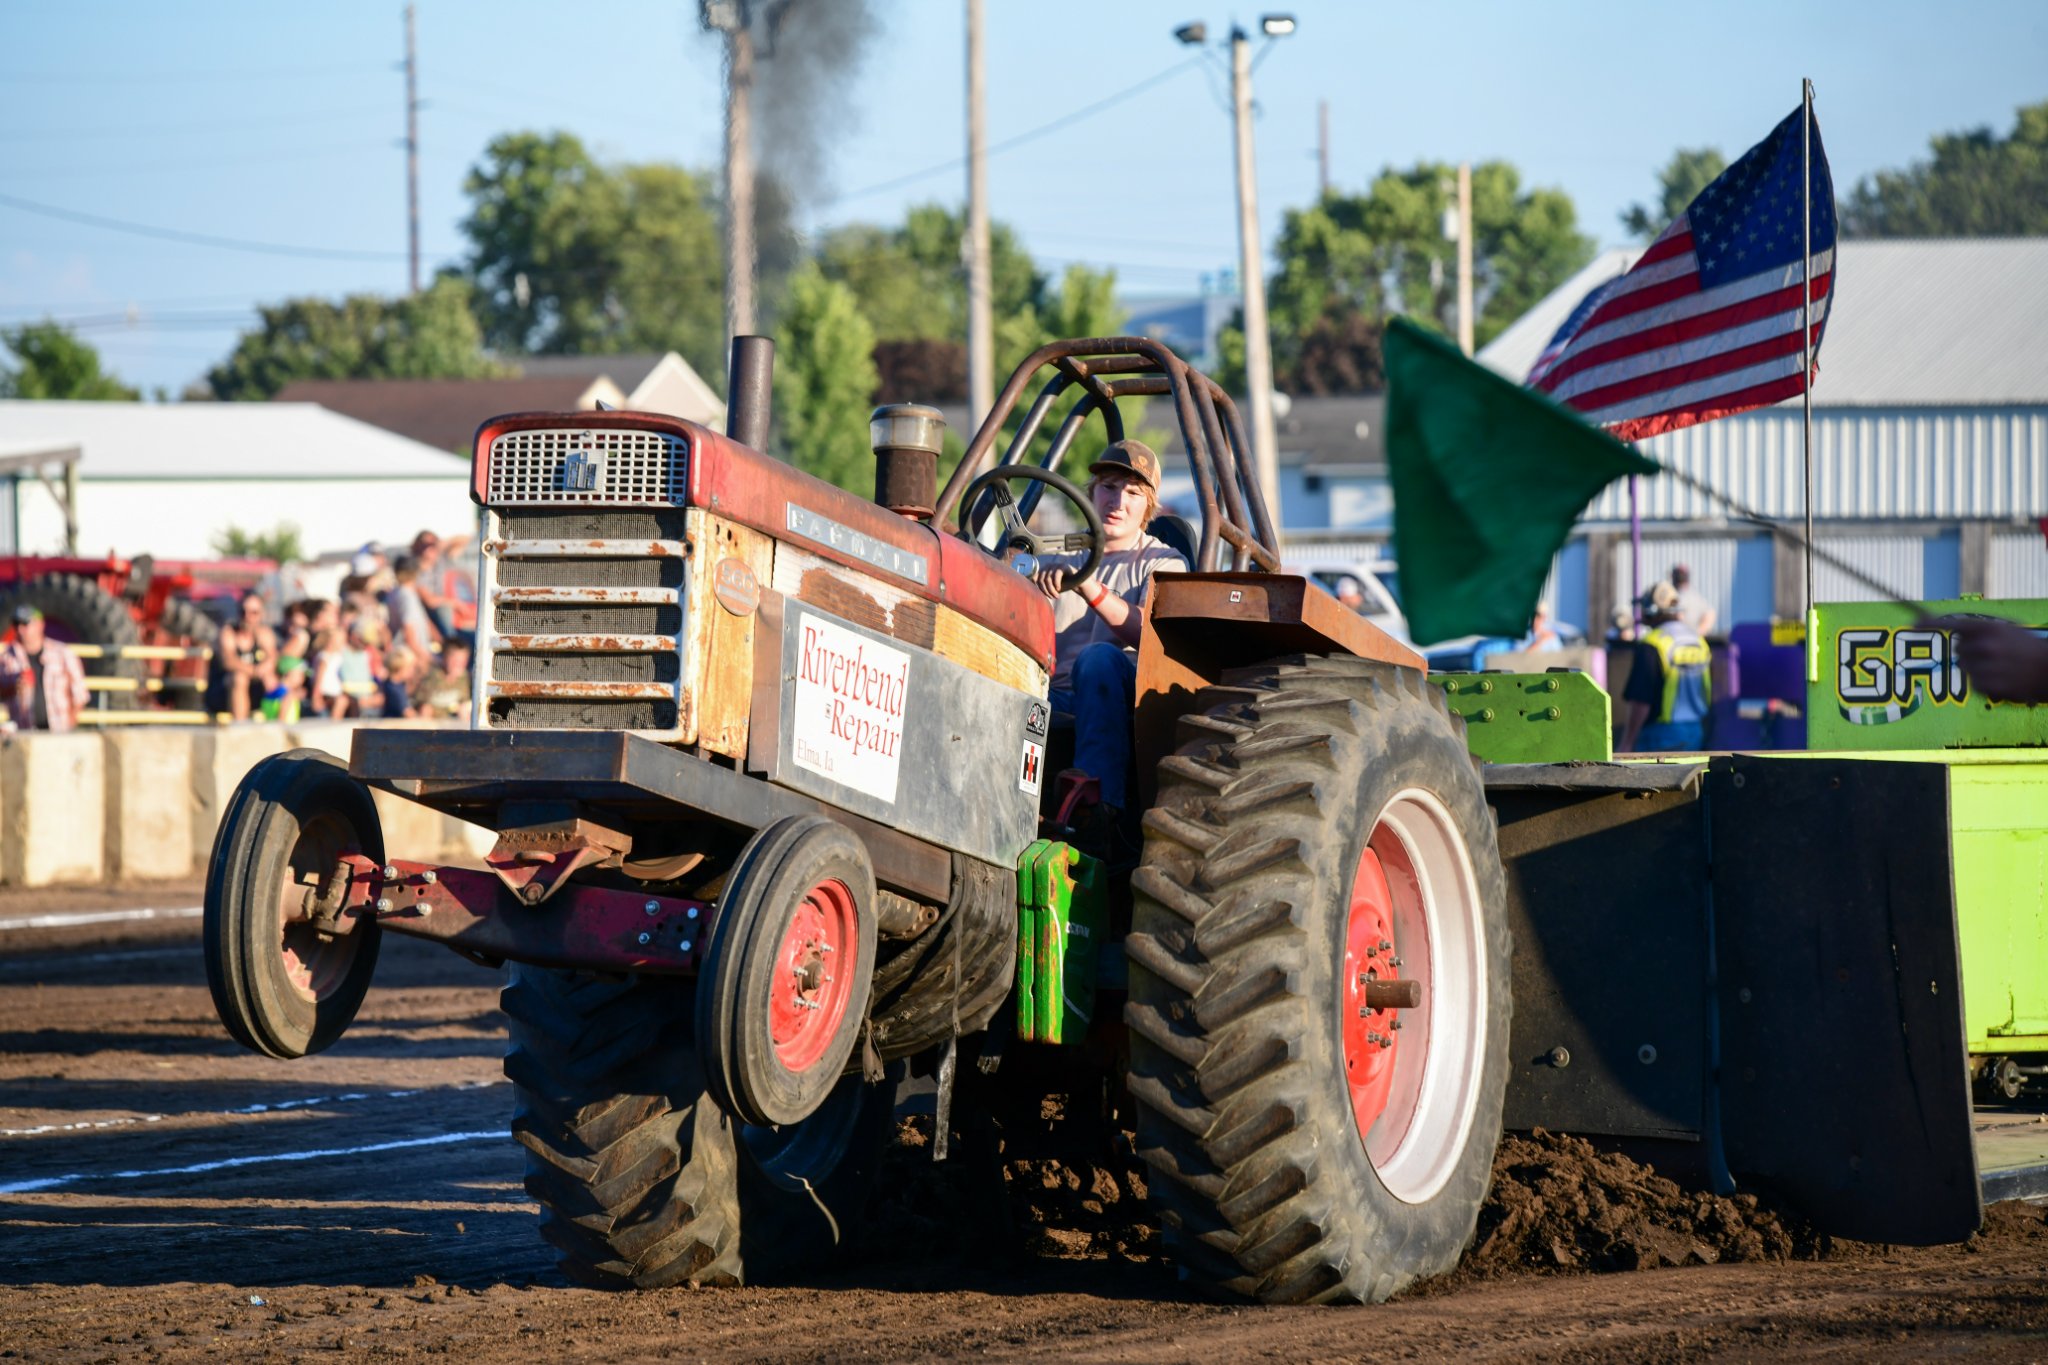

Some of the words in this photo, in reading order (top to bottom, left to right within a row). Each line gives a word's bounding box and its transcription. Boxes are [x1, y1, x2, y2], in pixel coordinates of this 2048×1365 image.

[722, 564, 754, 593] 560
[801, 626, 907, 717] Riverbend
[830, 699, 899, 757] Repair
